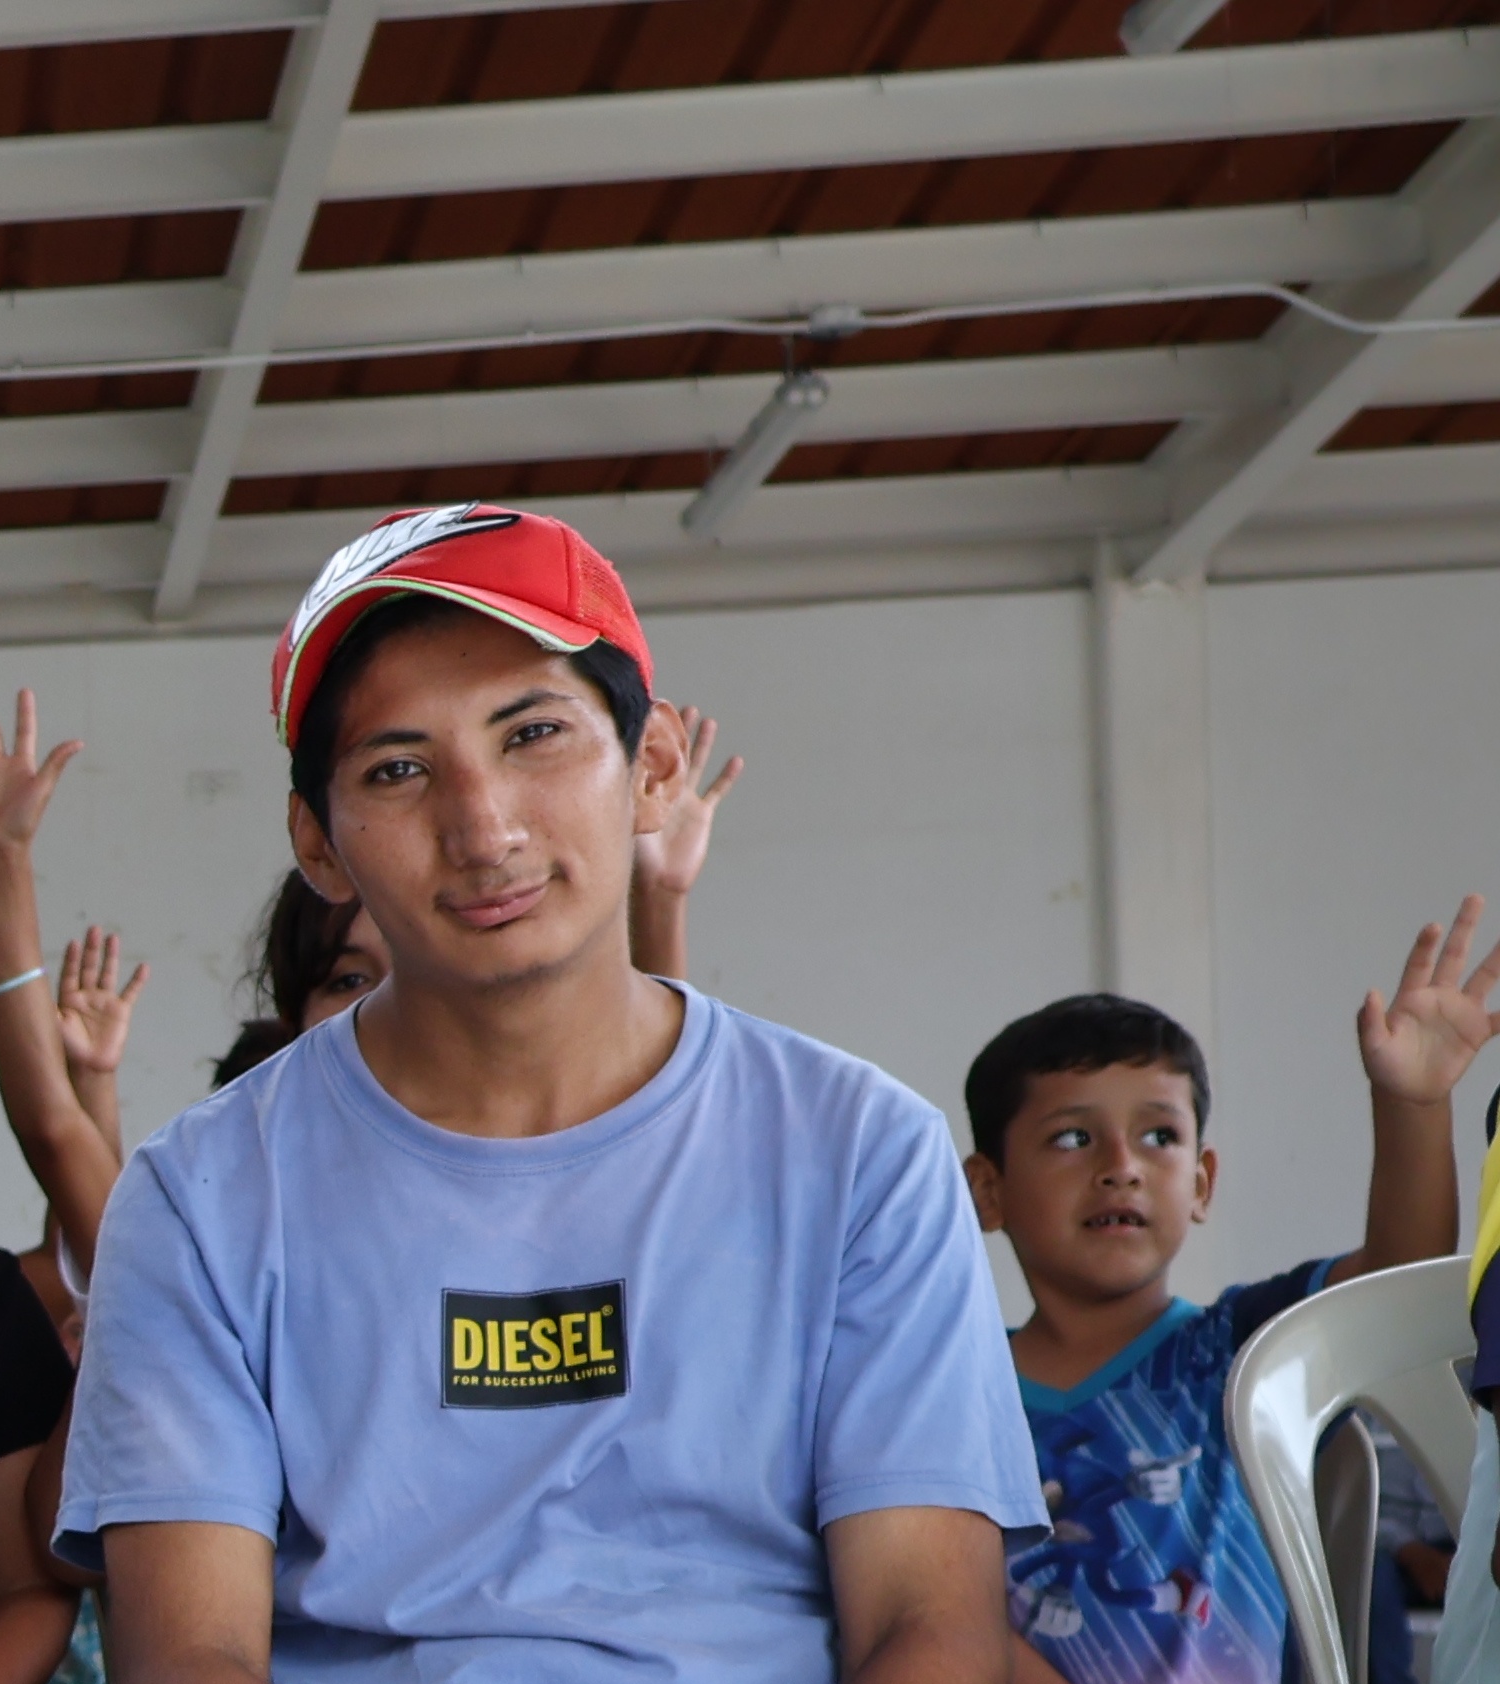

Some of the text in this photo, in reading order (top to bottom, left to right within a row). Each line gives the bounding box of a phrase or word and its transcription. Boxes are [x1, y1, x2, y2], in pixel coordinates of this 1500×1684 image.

[312, 502, 476, 600] NIKE
[453, 1364, 617, 1387] FOR SUCCESSFUL LIVING
